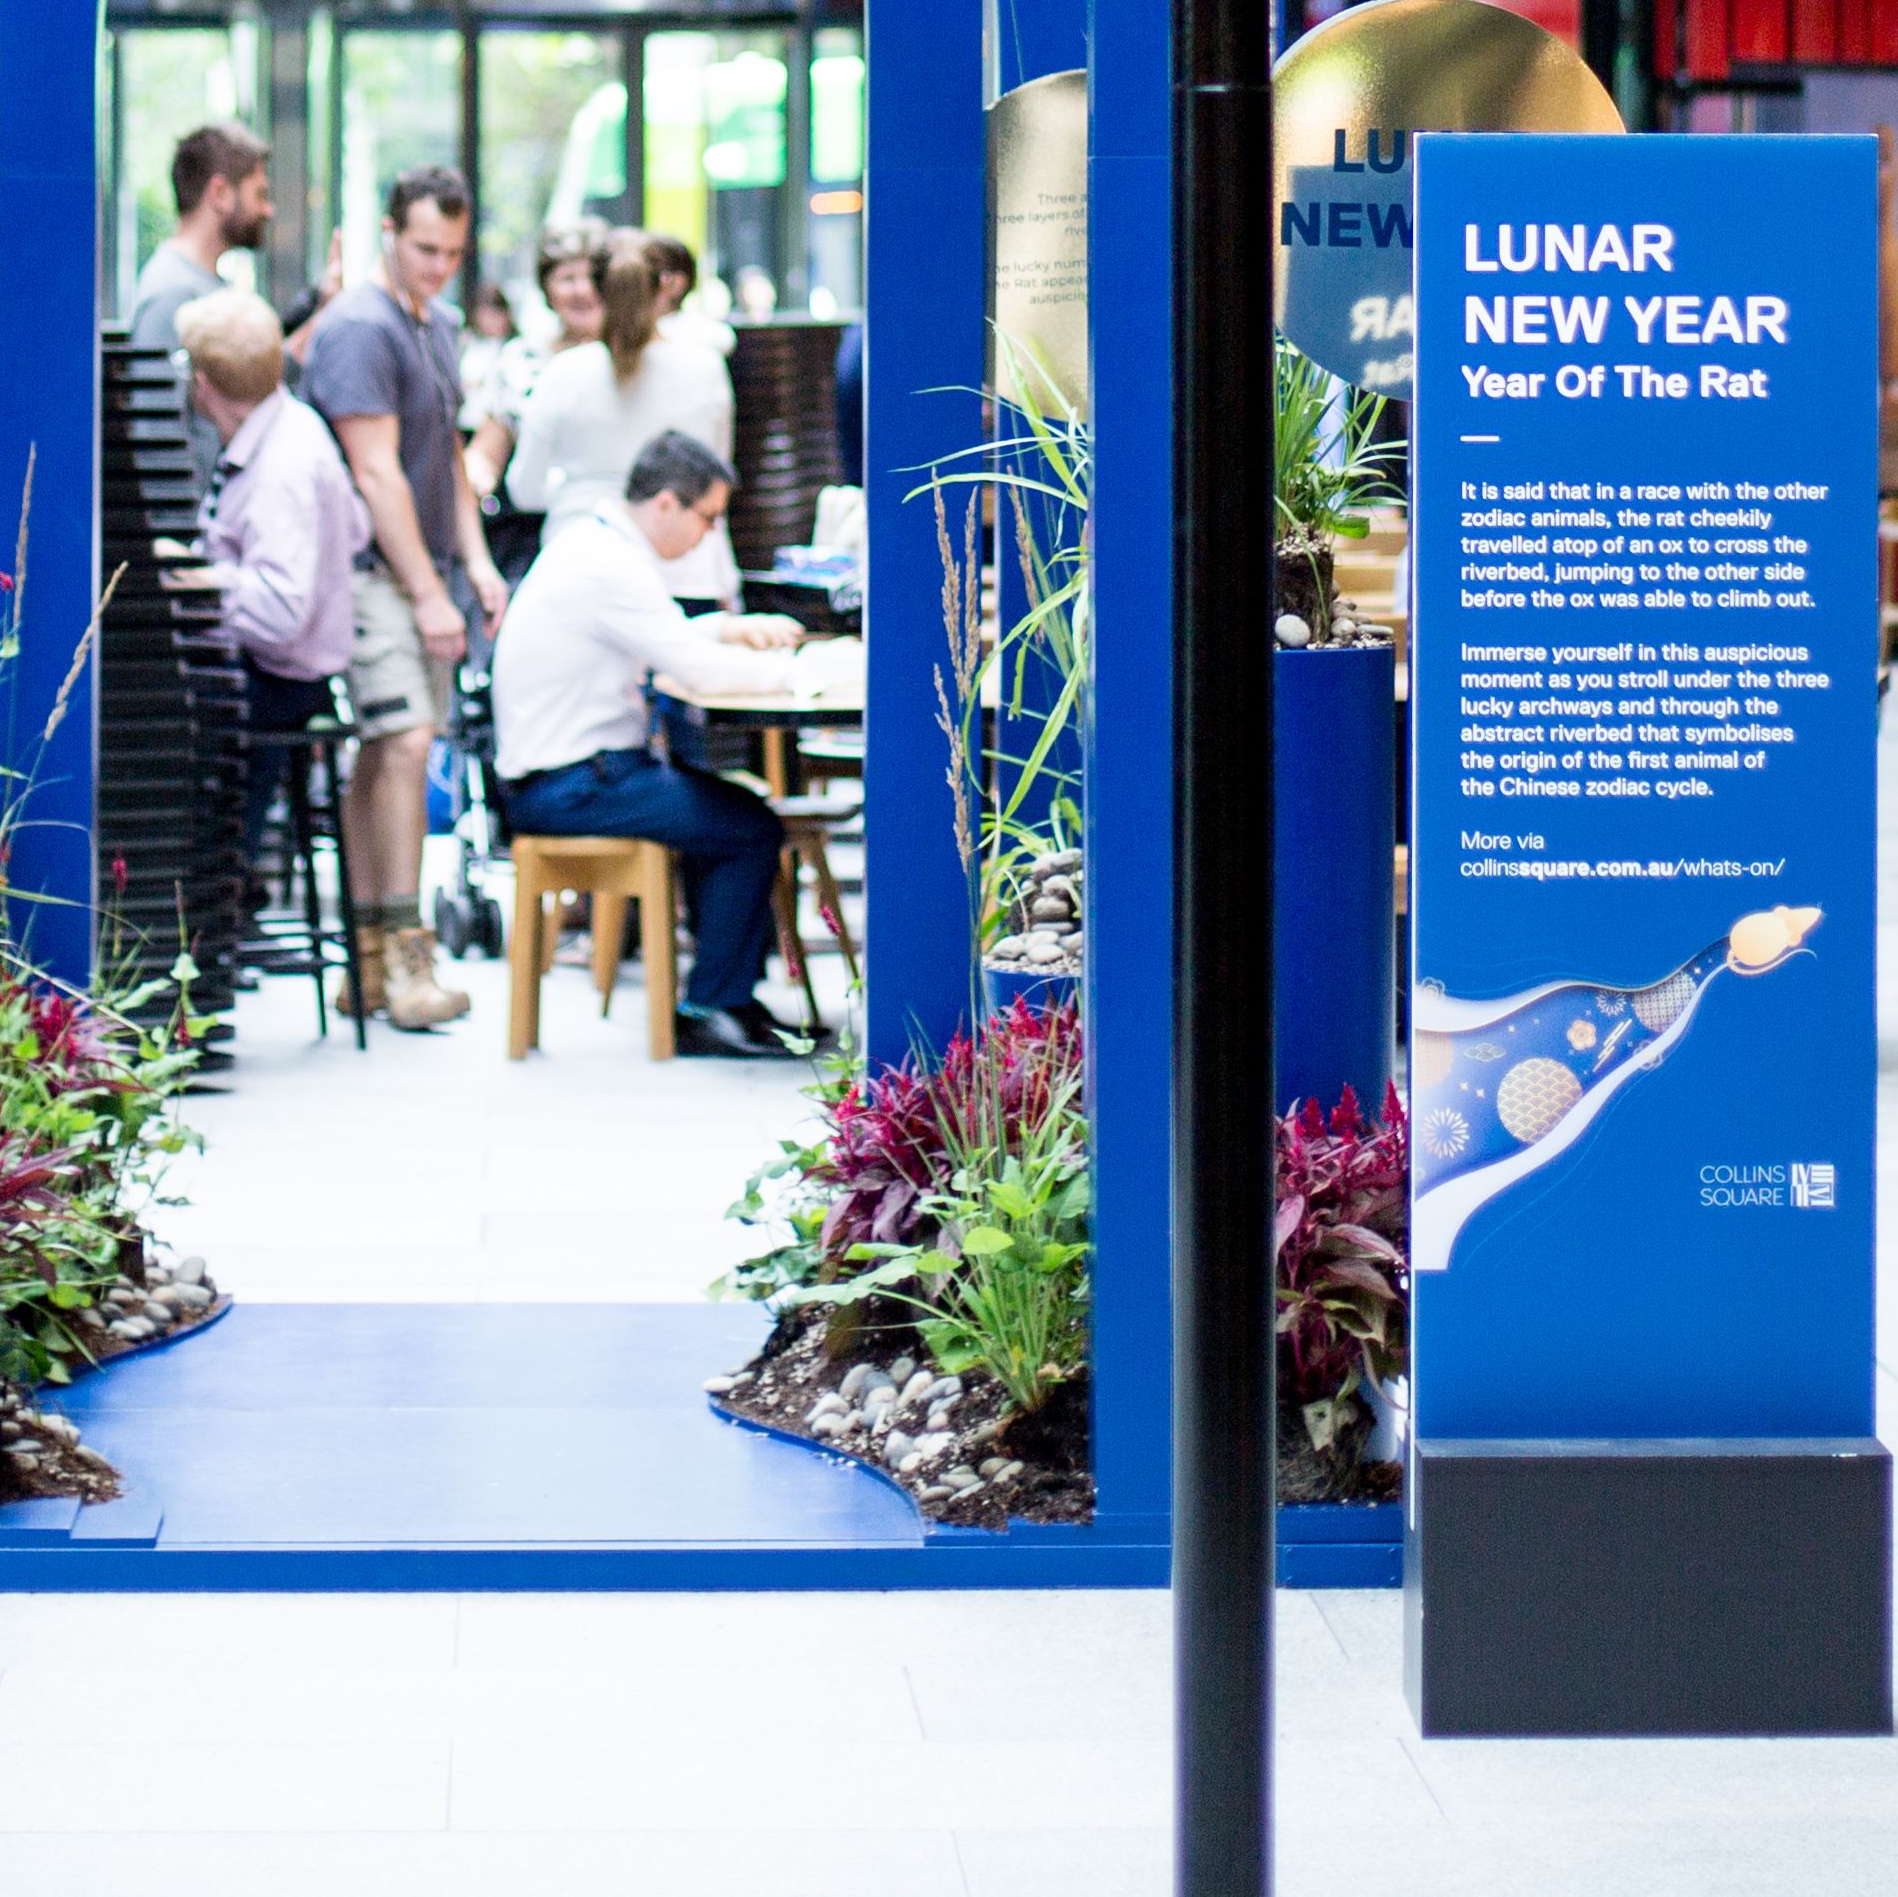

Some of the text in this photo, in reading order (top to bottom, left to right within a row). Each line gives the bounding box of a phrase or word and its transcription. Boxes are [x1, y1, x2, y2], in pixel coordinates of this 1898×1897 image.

[1027, 211, 1069, 224] layers
[1280, 202, 1414, 249] NEW
[1464, 223, 1676, 273] LUNAR
[1013, 261, 1049, 274] lucky
[1014, 277, 1039, 289] Rat
[1464, 295, 1790, 345] NEW YEAR
[1461, 364, 1769, 399] Year Of The Rat
[1461, 480, 1829, 501] It is said that in a race with the other
[1460, 507, 1773, 530] zodiac animals, the rat cheekily
[1460, 534, 1809, 559] travelled atop of an ox to cross the
[1460, 561, 1807, 586] riverbed, jumping to the other side
[1460, 588, 1816, 609] before the ox was able to climb out.
[1461, 642, 1810, 666] Immerse yourself in this auspicious
[1460, 669, 1831, 692] moment as you stroll under the three
[1460, 696, 1780, 720] lucky archways and through the
[1460, 722, 1795, 746] abstract riverbed that symbolises
[1460, 749, 1767, 775] the origin of the first animal of
[1460, 776, 1714, 800] the Chinese zodiac cycle.
[1460, 830, 1546, 850] More via
[1460, 857, 1786, 882] collinssquare.com.au/whats-on/
[1699, 1164, 1786, 1184] COLLINS
[1699, 1187, 1785, 1207] SQUARE
